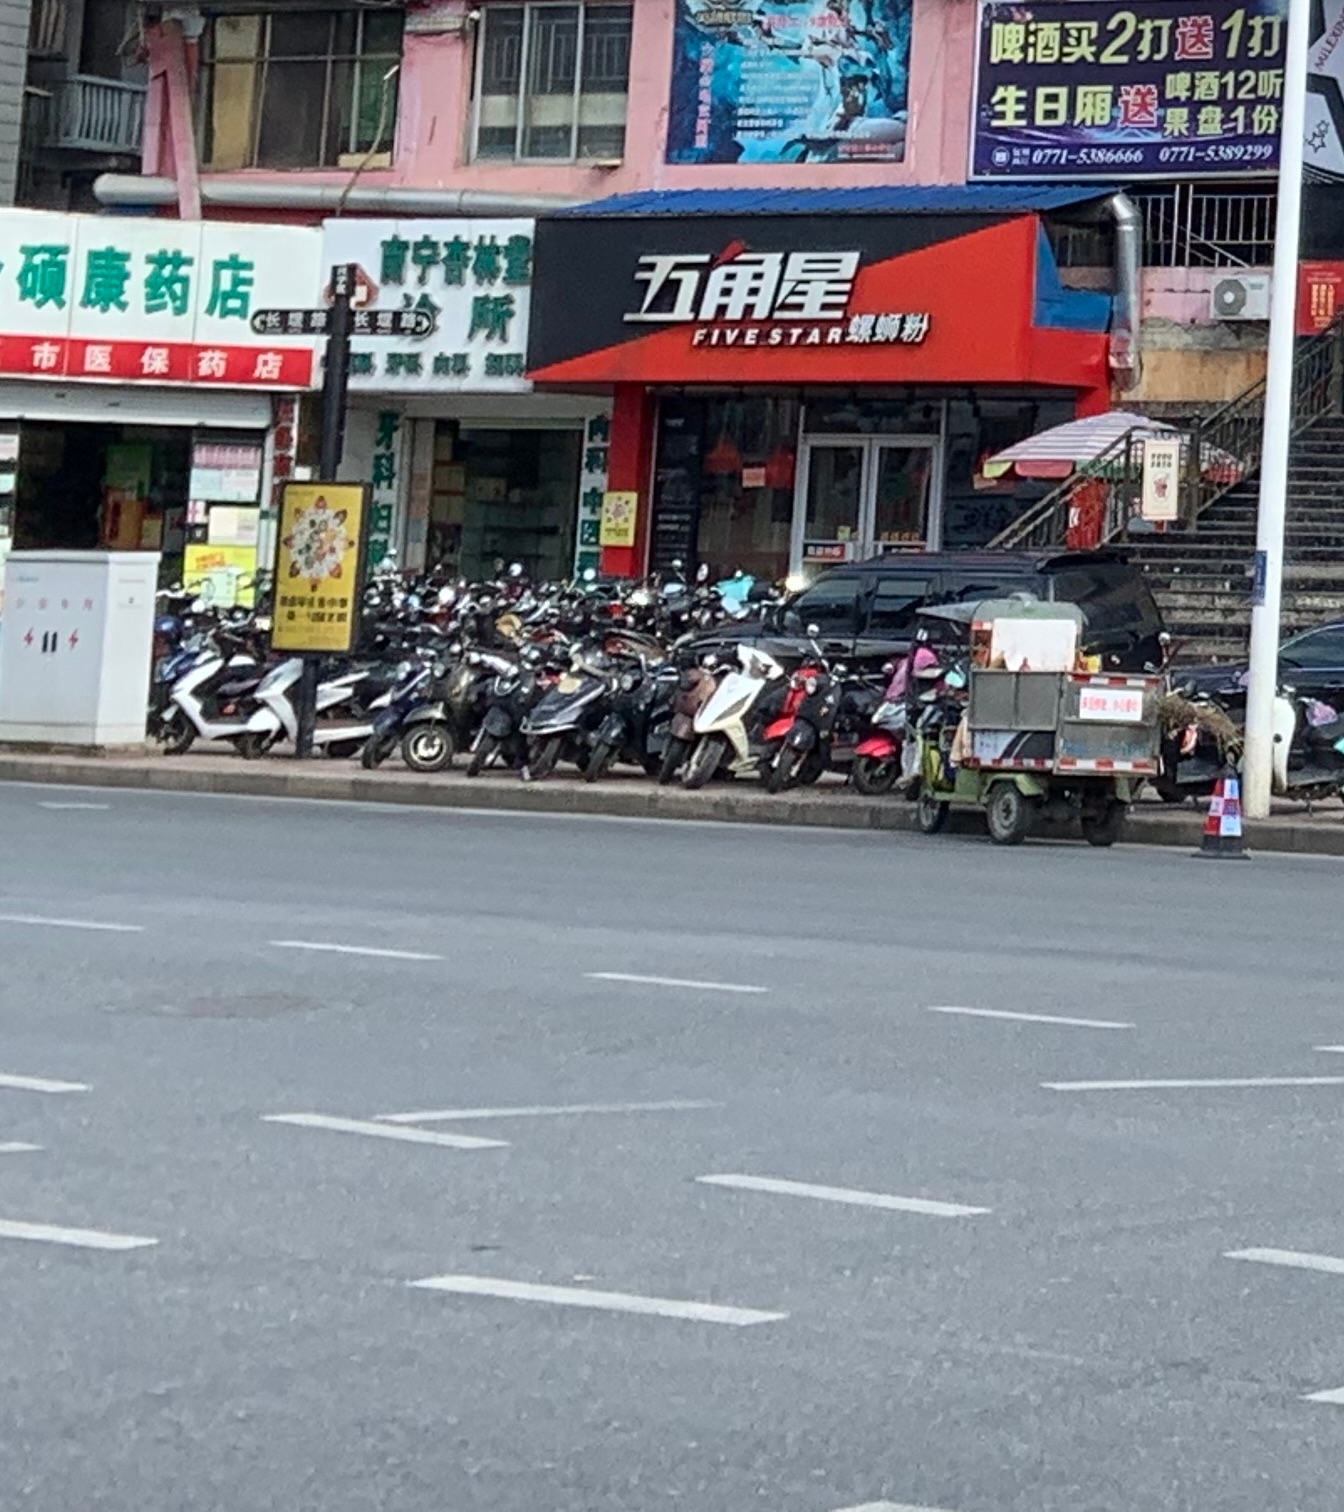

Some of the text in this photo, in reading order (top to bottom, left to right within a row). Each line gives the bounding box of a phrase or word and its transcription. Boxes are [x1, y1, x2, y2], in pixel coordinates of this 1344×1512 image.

[989, 9, 1281, 65] 啤酒买2打送1打
[990, 85, 1158, 128] 生日厢送
[1032, 148, 1143, 165] 0771-5386666
[1159, 144, 1273, 161] 0771-5389299
[0, 244, 255, 320] 硕康药店
[622, 239, 861, 322] 五角星
[692, 329, 759, 345] FIVE
[768, 327, 843, 345] STAR
